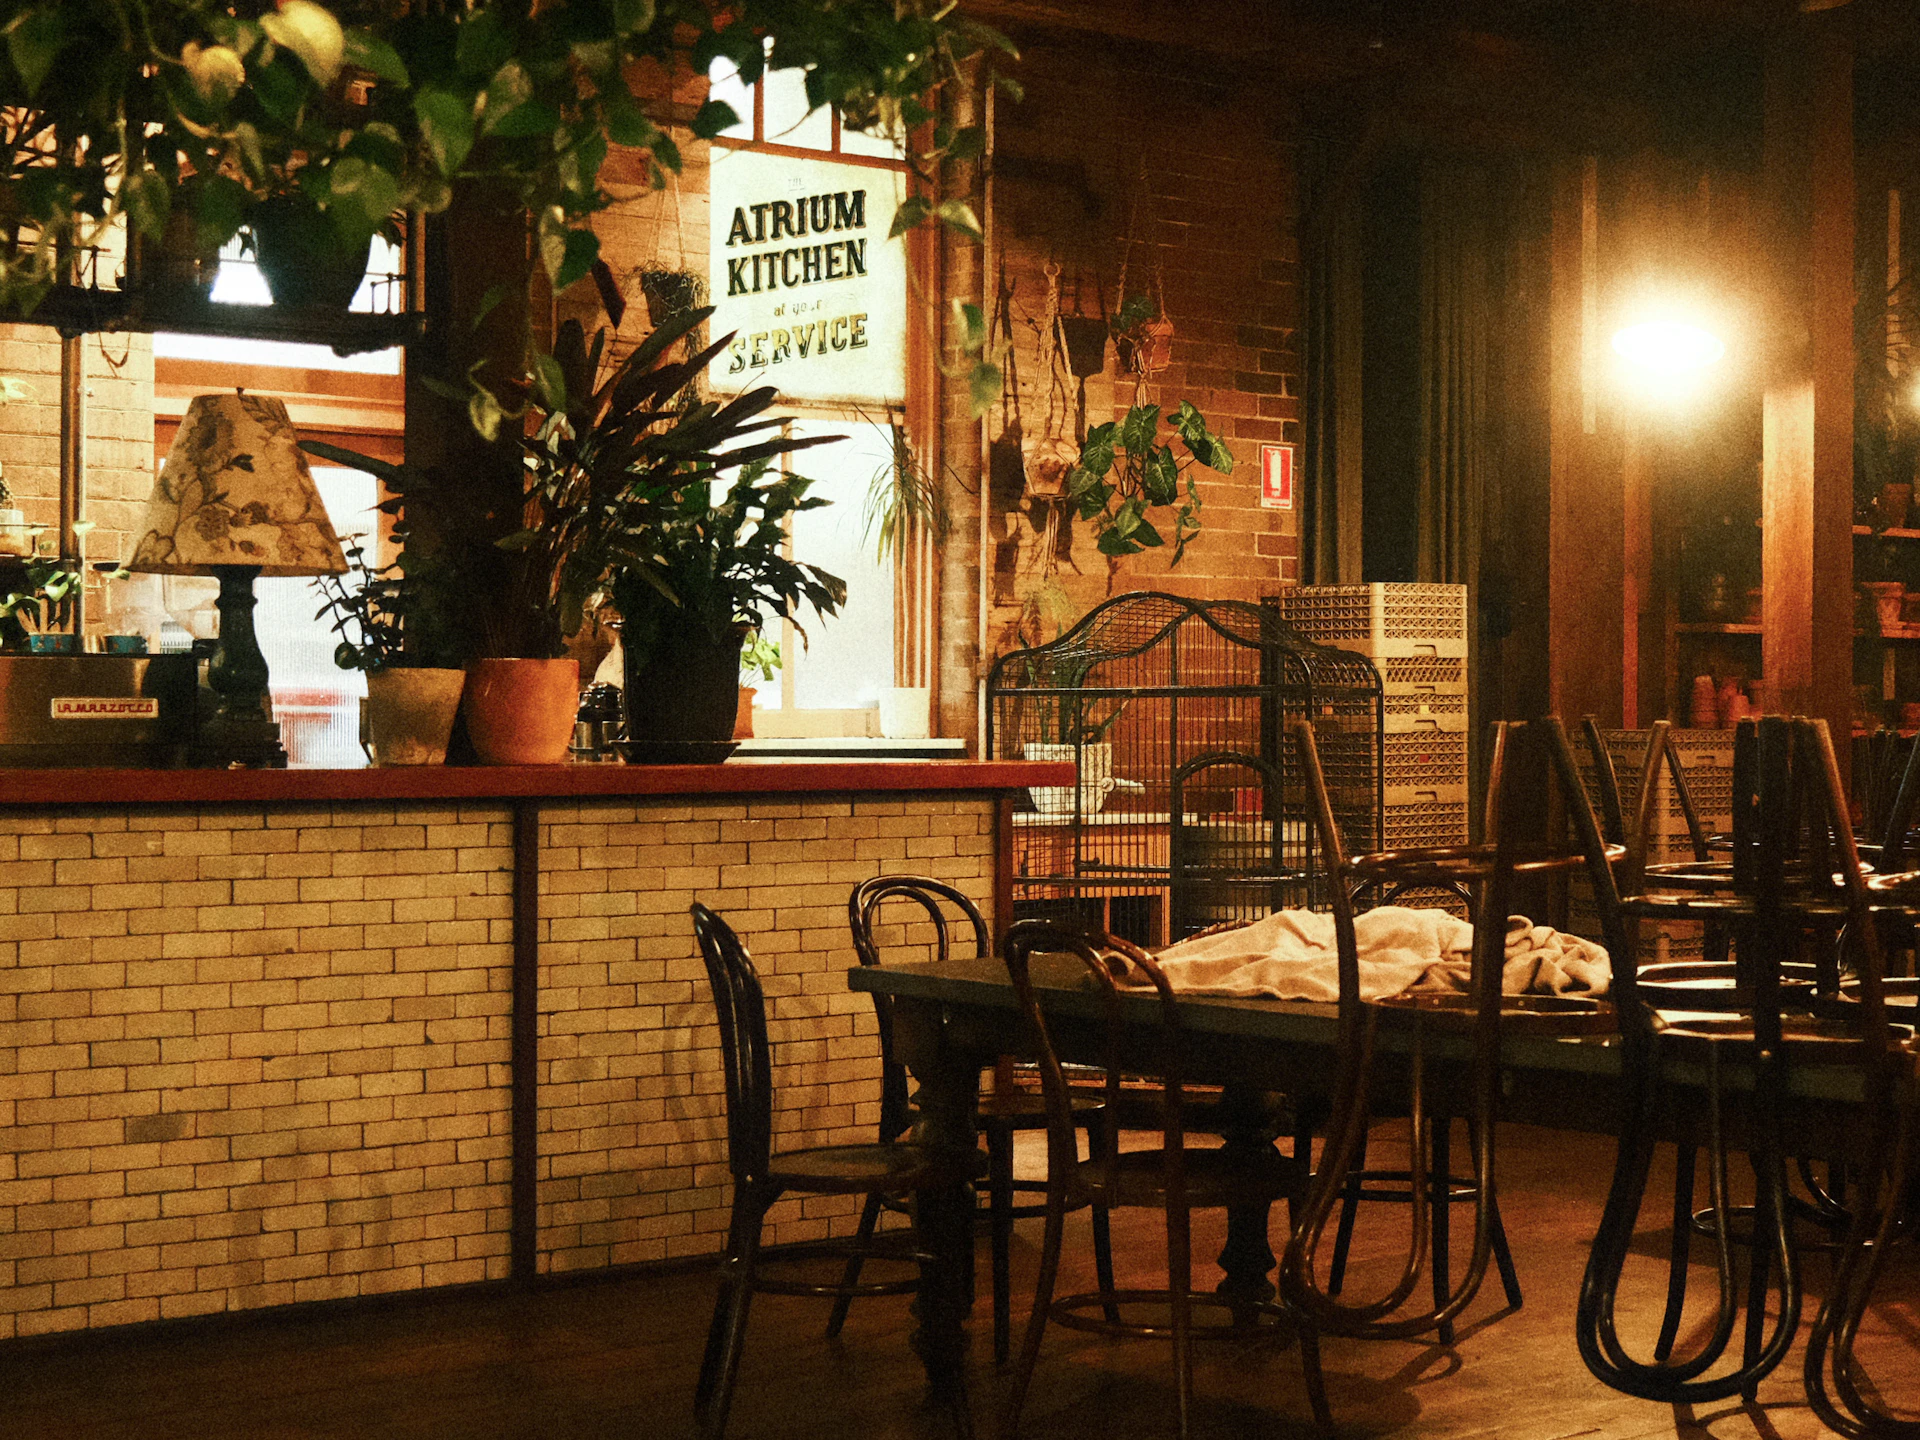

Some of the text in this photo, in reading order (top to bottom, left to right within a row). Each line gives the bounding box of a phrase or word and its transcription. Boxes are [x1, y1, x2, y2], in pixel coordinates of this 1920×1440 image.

[725, 189, 867, 247] ATRIUM
[727, 238, 868, 297] KITCHEN
[773, 302, 786, 317] at
[727, 312, 869, 374] SERVICE
